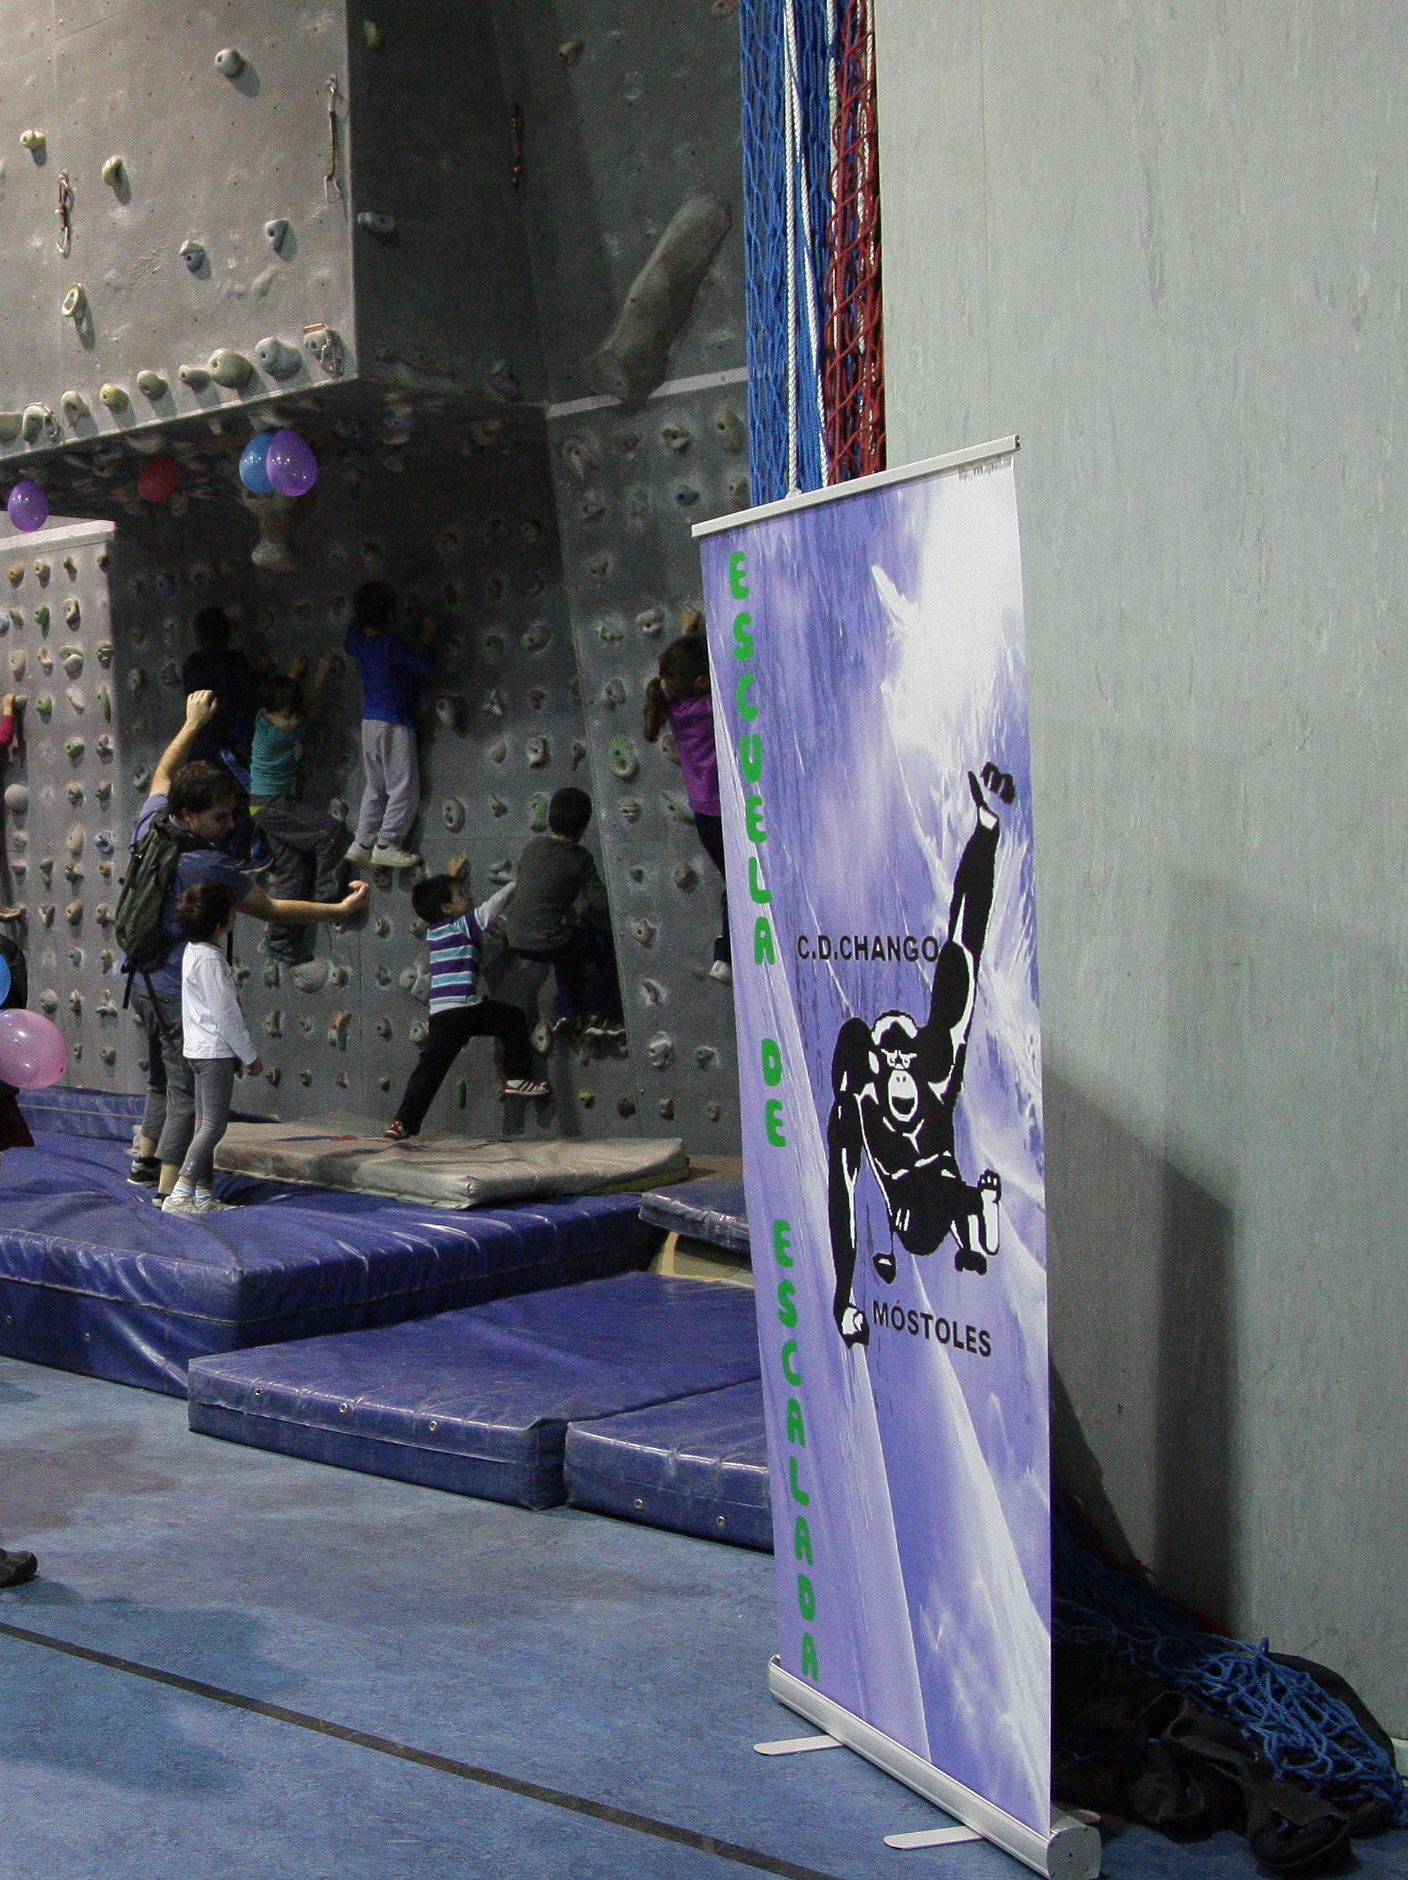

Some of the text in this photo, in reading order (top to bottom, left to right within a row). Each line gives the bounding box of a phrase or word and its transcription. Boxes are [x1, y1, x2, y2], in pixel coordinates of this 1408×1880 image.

[797, 935, 939, 962] C.D.CHANGO
[729, 551, 820, 1682] ESCUELA DE ESCALADA
[872, 1299, 992, 1357] MÓSTOLES
